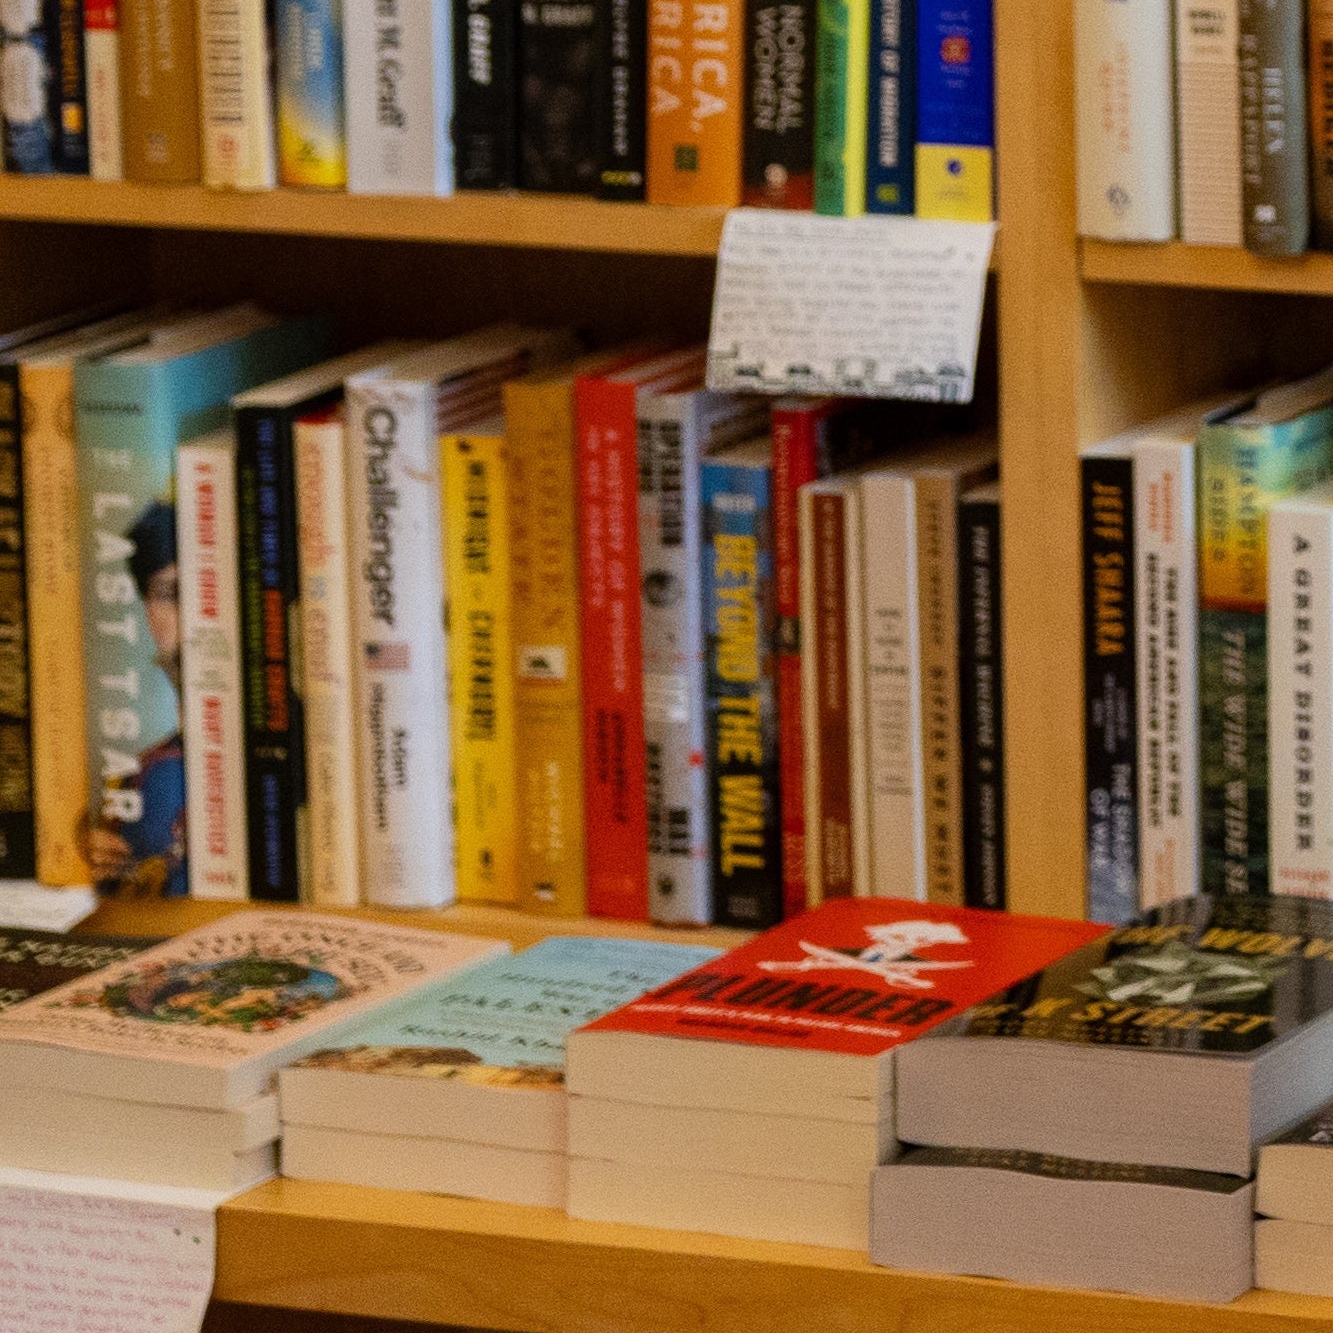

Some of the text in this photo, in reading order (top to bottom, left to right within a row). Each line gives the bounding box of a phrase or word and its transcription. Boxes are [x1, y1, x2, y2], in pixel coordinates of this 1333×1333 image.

[363, 406, 397, 625] Challenger
[715, 533, 766, 877] BEYOND THE WALL
[666, 972, 955, 1028] PLUNDER
